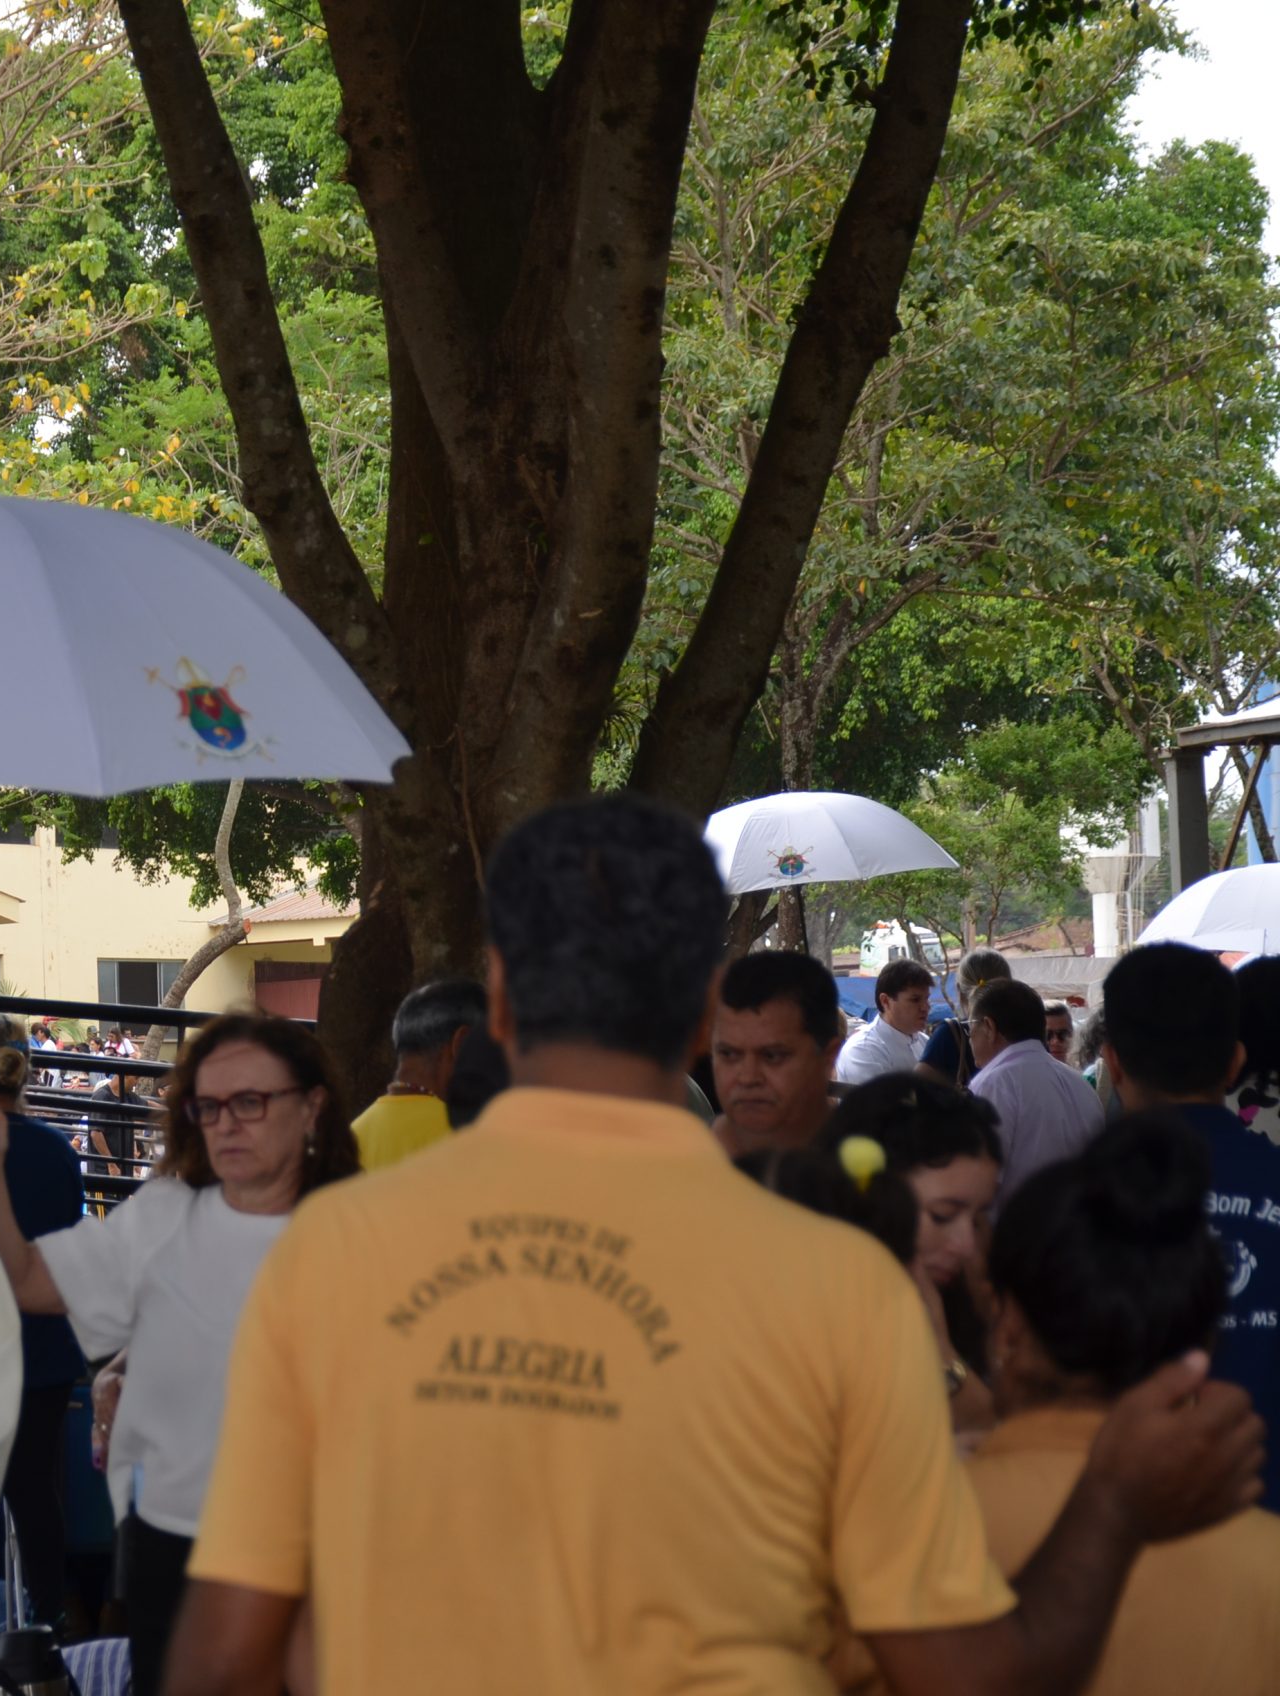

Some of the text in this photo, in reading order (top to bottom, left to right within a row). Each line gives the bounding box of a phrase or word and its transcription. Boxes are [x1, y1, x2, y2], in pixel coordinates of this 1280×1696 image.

[1205, 1191, 1280, 1225] Bom Je
[386, 1244, 680, 1366] NOSSA SENHORA
[1252, 1311, 1277, 1327] MS
[438, 1335, 606, 1390] ALEGRIA
